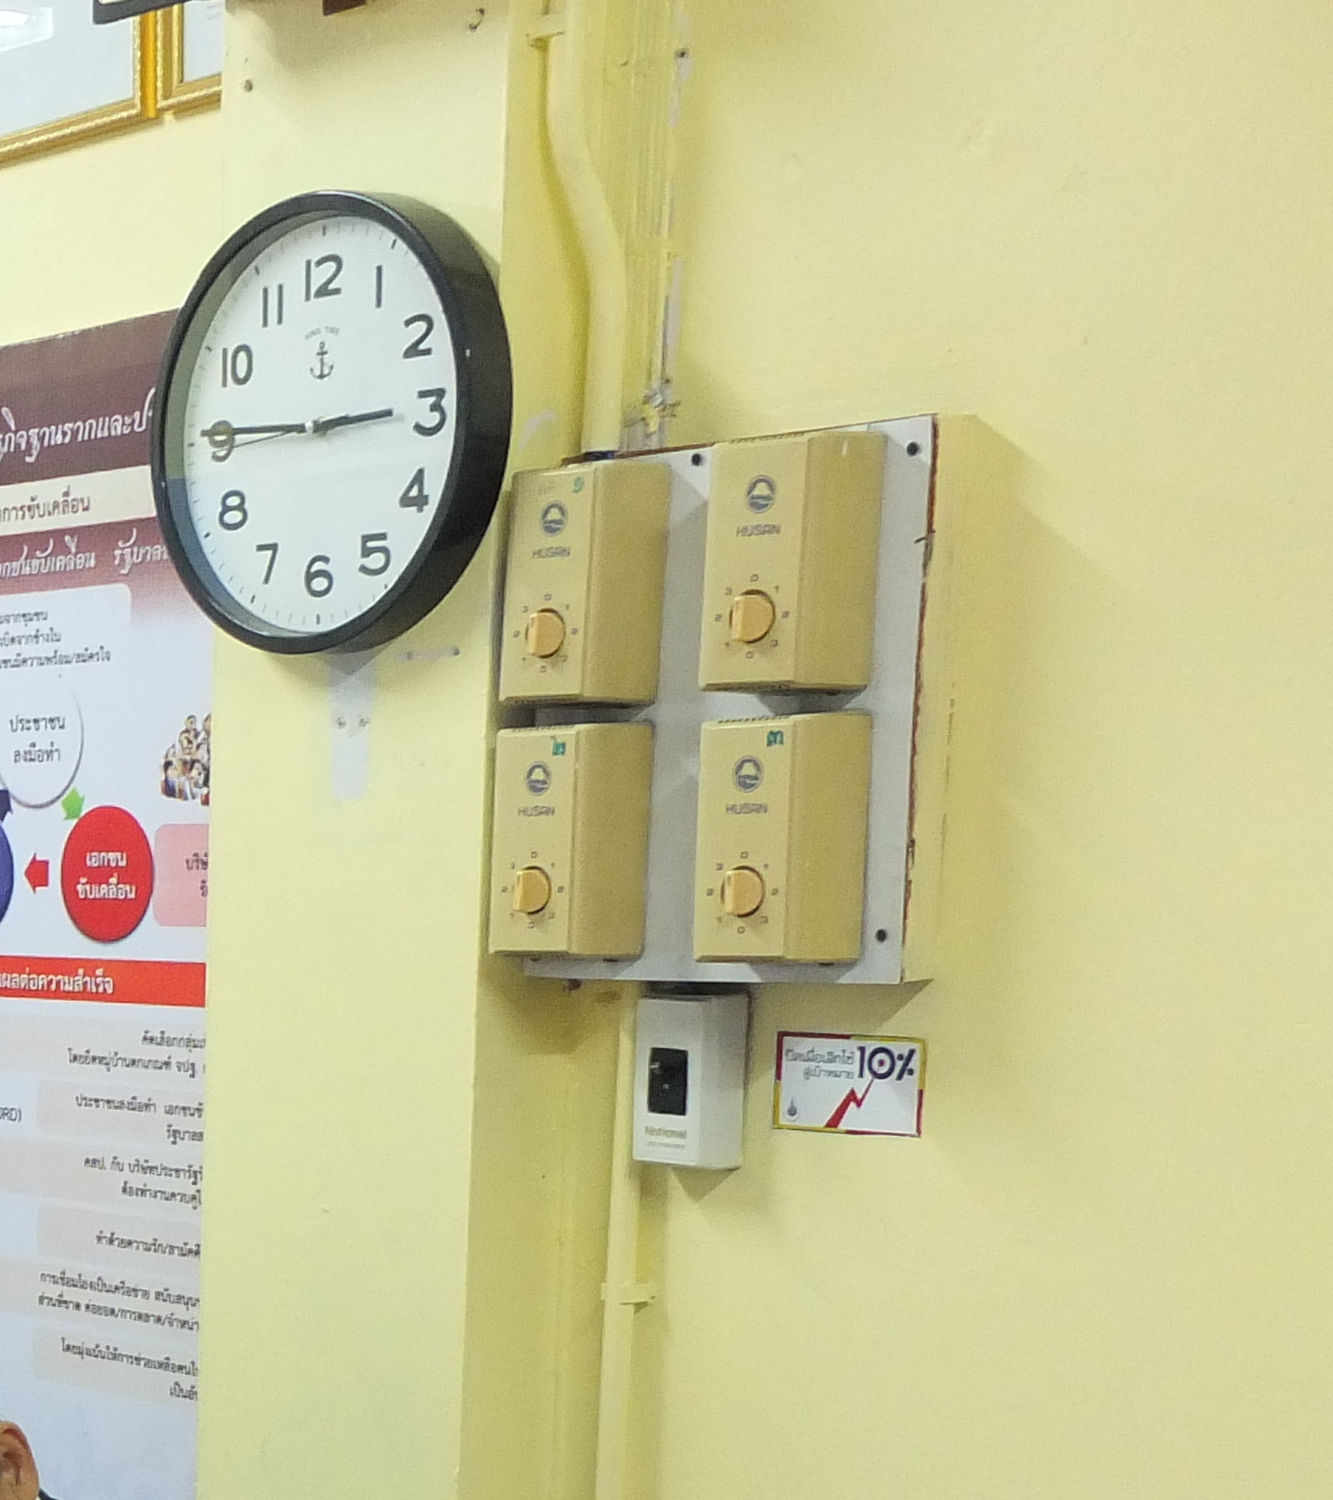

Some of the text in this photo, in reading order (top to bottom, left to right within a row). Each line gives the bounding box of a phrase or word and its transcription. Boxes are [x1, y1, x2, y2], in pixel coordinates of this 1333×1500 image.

[304, 253, 342, 302] 12
[375, 265, 383, 309] 1
[262, 283, 284, 328] 11
[402, 313, 434, 359] 2
[221, 343, 253, 389] 10
[413, 387, 447, 437] 3
[207, 420, 234, 463] 9
[218, 489, 249, 531] 8
[399, 467, 429, 514] 4
[255, 542, 279, 585] 7
[304, 555, 334, 599] 6
[358, 533, 391, 577] 5
[10, 715, 65, 733] ประชาชน
[14, 741, 60, 763] ลงมือทำ
[86, 852, 127, 867] เอกชน
[77, 873, 136, 899] ขับเคลื่อน
[857, 1046, 916, 1081] 10%
